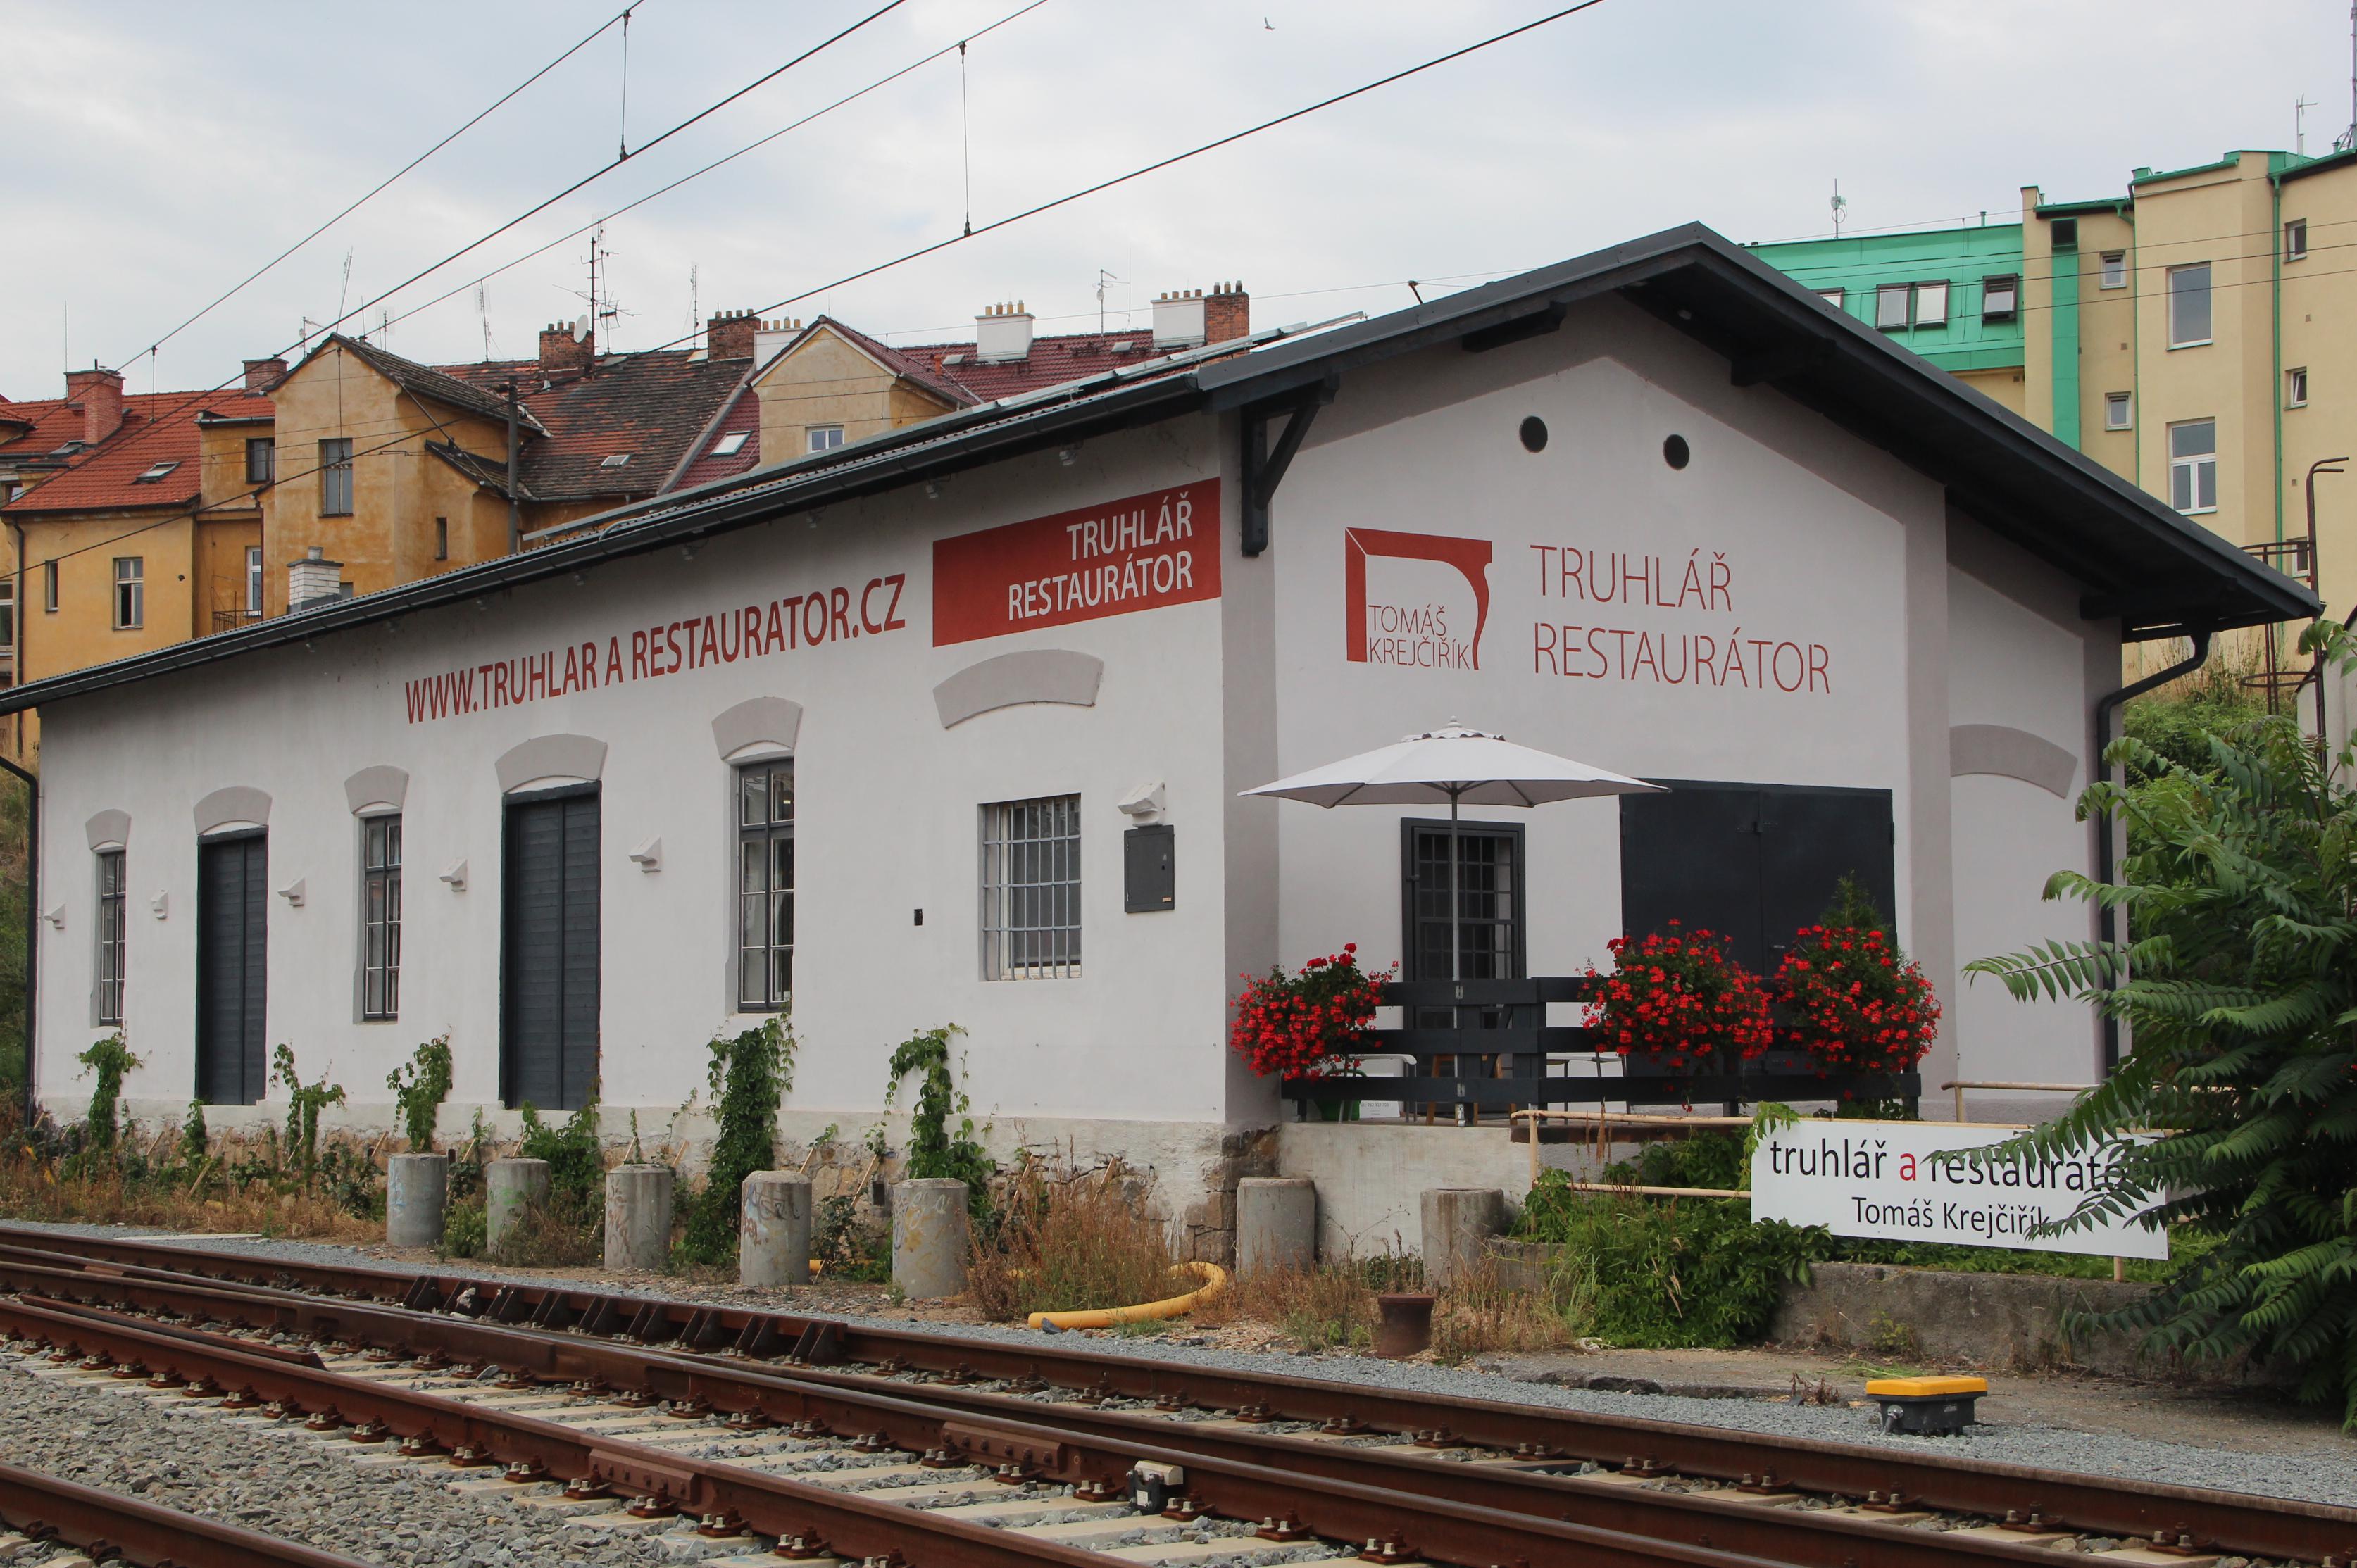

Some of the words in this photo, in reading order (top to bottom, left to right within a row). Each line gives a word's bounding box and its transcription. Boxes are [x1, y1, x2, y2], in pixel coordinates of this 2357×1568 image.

[1066, 491, 1192, 560] TRUHLÁŘ
[1008, 551, 1193, 620] RESTAURÁTOR
[1530, 545, 1732, 611] TRUHLÁŘ
[1368, 604, 1446, 636] TOMÁŠ
[1370, 636, 1470, 670] KREJČIŘÍK
[1534, 622, 1830, 694] RESTAURÁTOR
[1770, 1138, 1887, 1179] truhlář
[1899, 1153, 1916, 1181] a
[1851, 1196, 1934, 1228] Tomáš
[1943, 1202, 2051, 1239] Krejčiřík
